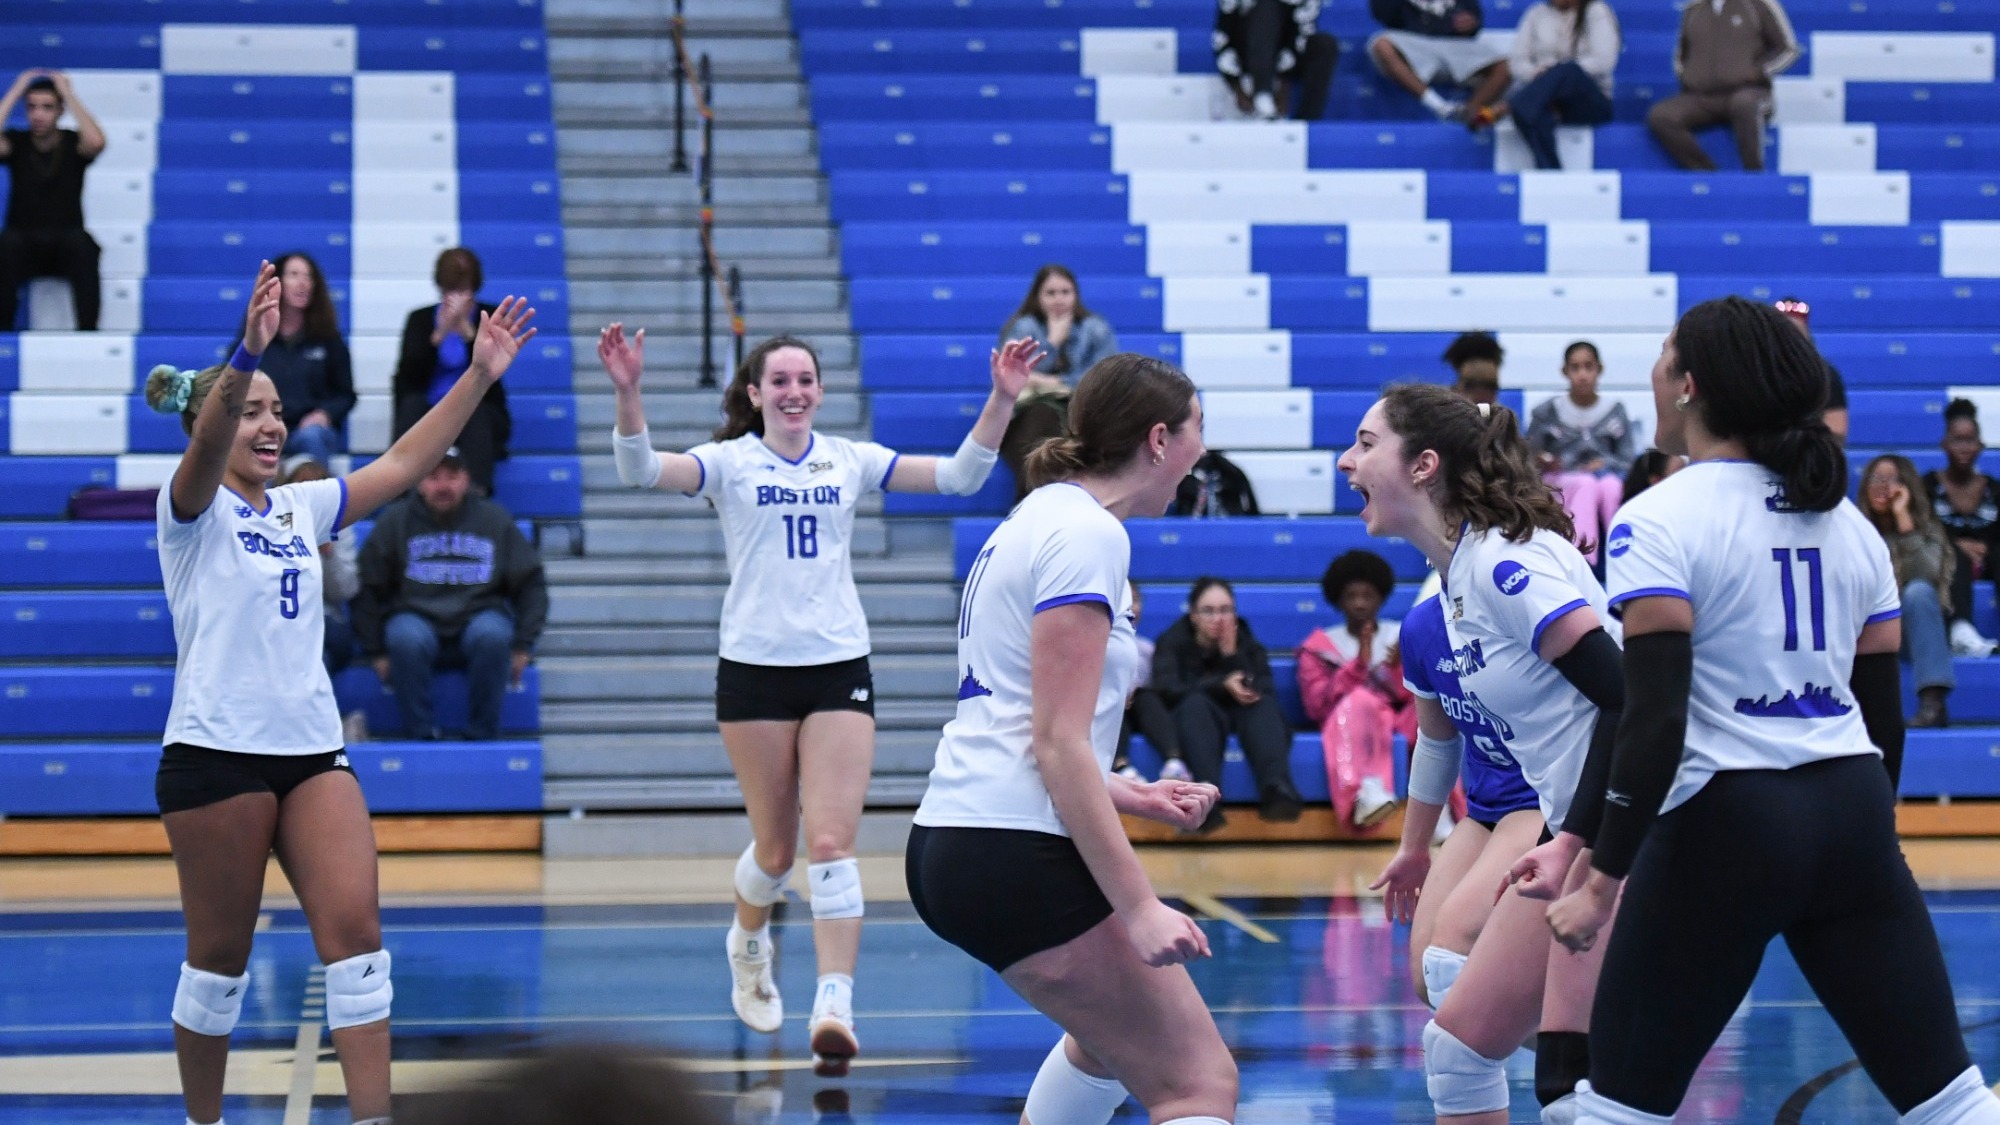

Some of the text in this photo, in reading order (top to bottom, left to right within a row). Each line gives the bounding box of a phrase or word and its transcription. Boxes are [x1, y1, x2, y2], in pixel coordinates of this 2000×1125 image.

[756, 485, 841, 506] BOSTON
[782, 515, 818, 560] 18
[279, 568, 300, 620] 9
[1501, 568, 1531, 594] NCAA
[1772, 547, 1826, 652] 11
[1438, 691, 1487, 727] BOST
